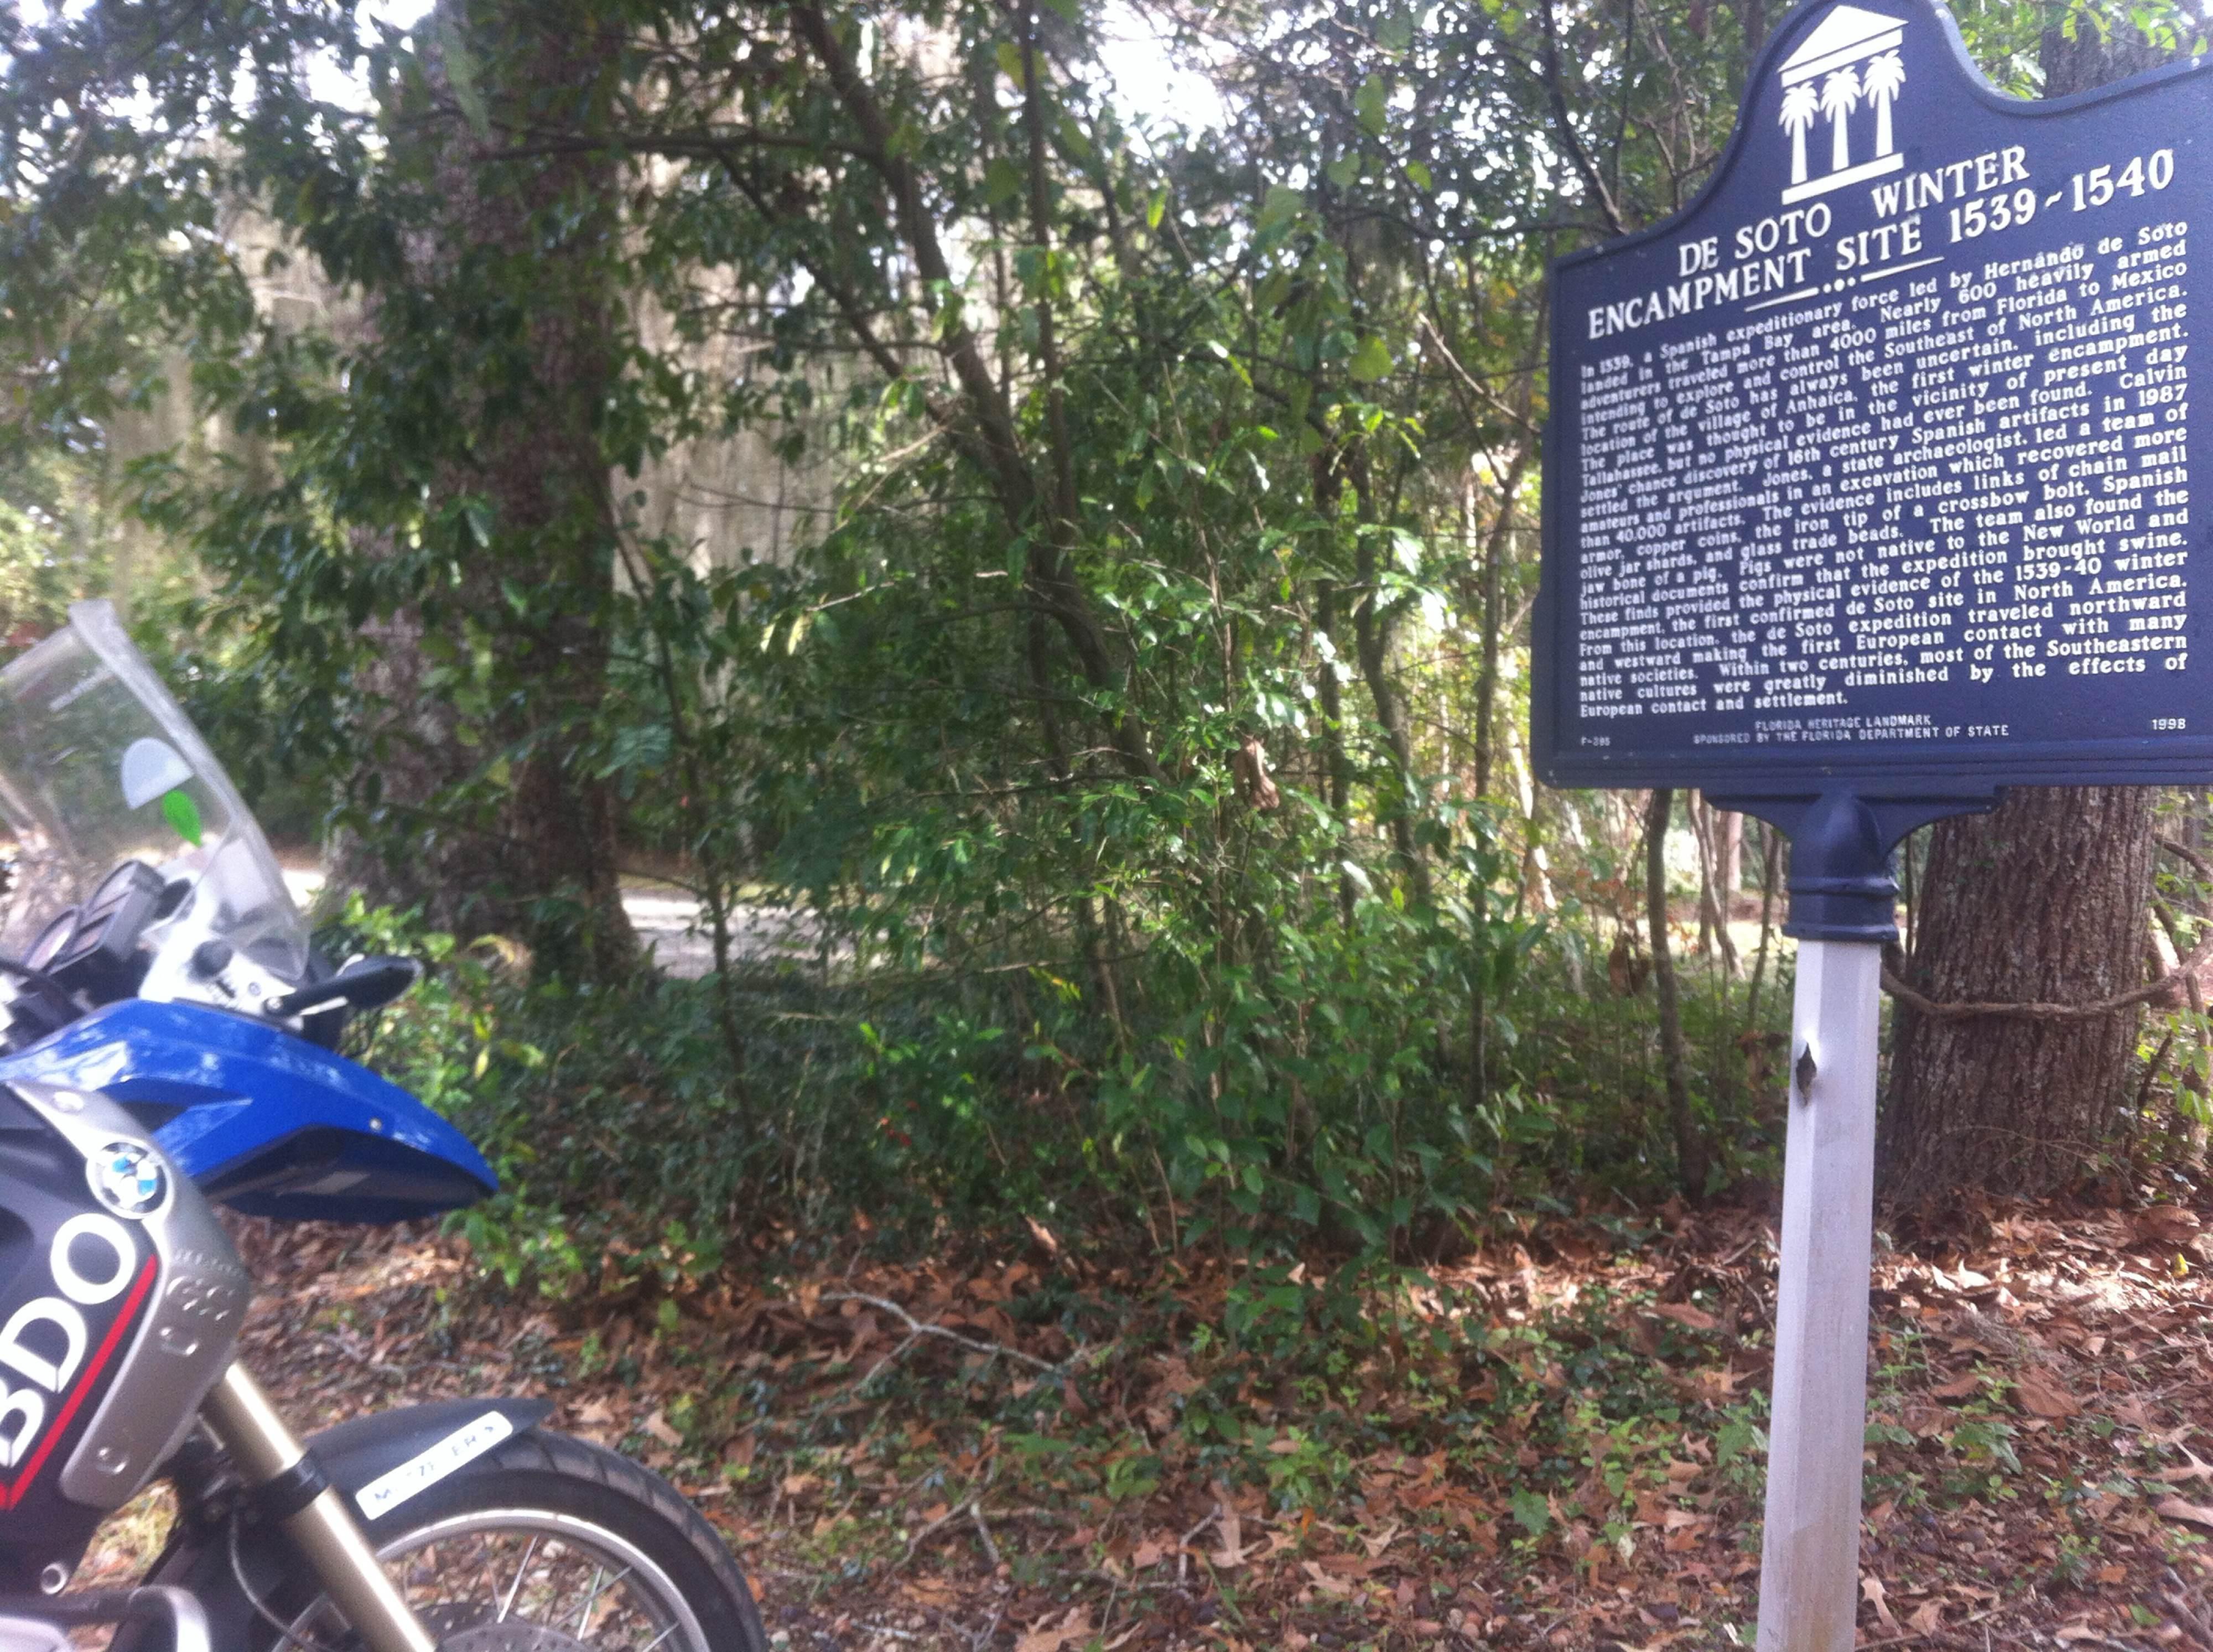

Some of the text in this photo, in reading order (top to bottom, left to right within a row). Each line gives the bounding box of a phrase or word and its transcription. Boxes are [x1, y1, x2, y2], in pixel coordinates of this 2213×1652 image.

[1679, 144, 2030, 277] DE SOTO WINTER
[1588, 248, 1811, 339] ENCAMPMENT
[1836, 216, 1923, 271] SITE
[1726, 301, 1842, 343] expeditionary
[1851, 289, 1899, 311] force
[1909, 277, 1937, 297] led
[1949, 271, 1972, 294] by
[2097, 237, 2122, 254] de
[2137, 221, 2188, 245] Soto
[1783, 262, 2187, 362] than 4000 miles from Florida to Mexico
[1880, 238, 2186, 323] Nearly 600 heavily armed
[1779, 284, 2187, 381] control the Southeast of North America.
[1789, 303, 2186, 402] always been including the
[1870, 322, 2188, 397] the first winter encampment.
[1706, 344, 2188, 447] thought in the vicinity of present day
[1724, 359, 2187, 464] physical evidence had ever been found. Calvin
[1682, 382, 2188, 484] discovery 16th century Spanish artifacts in 1987
[1842, 402, 2188, 474] state led a team of
[1678, 427, 2186, 521] professionals excavation which recovered more
[1794, 465, 2187, 533] iron tip of a crossbow bolt. Spanish
[1800, 444, 2186, 515] evidence includes links of chain mail
[1783, 507, 2188, 569] were not native to the New World and
[1791, 532, 1837, 551] trade
[1929, 515, 1965, 533] The
[1975, 511, 2023, 528] team
[2033, 502, 2076, 521] also
[2084, 491, 2142, 515] found
[2153, 488, 2188, 506] the
[1650, 531, 2188, 602] documents confirm that the expedition brought swine.
[1749, 572, 2186, 625] confirmed de Soto site in North America.
[1773, 550, 2188, 609] physical evidence of the 1539-40 winter
[1794, 590, 2186, 638] Soto expedition traveled northward
[1801, 613, 2187, 654] first European contact with many
[1920, 635, 2186, 664] most of the Southeastern
[1763, 652, 2188, 695] greatly diminished by the effects of
[1755, 714, 1931, 733] FLORIDA HERITAGE LANDMARK
[1776, 730, 1798, 742] THE
[1802, 729, 1852, 742] FLORIDA
[1858, 725, 1941, 740] DEPARTMENT
[1946, 725, 1960, 737] OF
[1967, 724, 2009, 737] STATE
[2152, 718, 2186, 730] 1998
